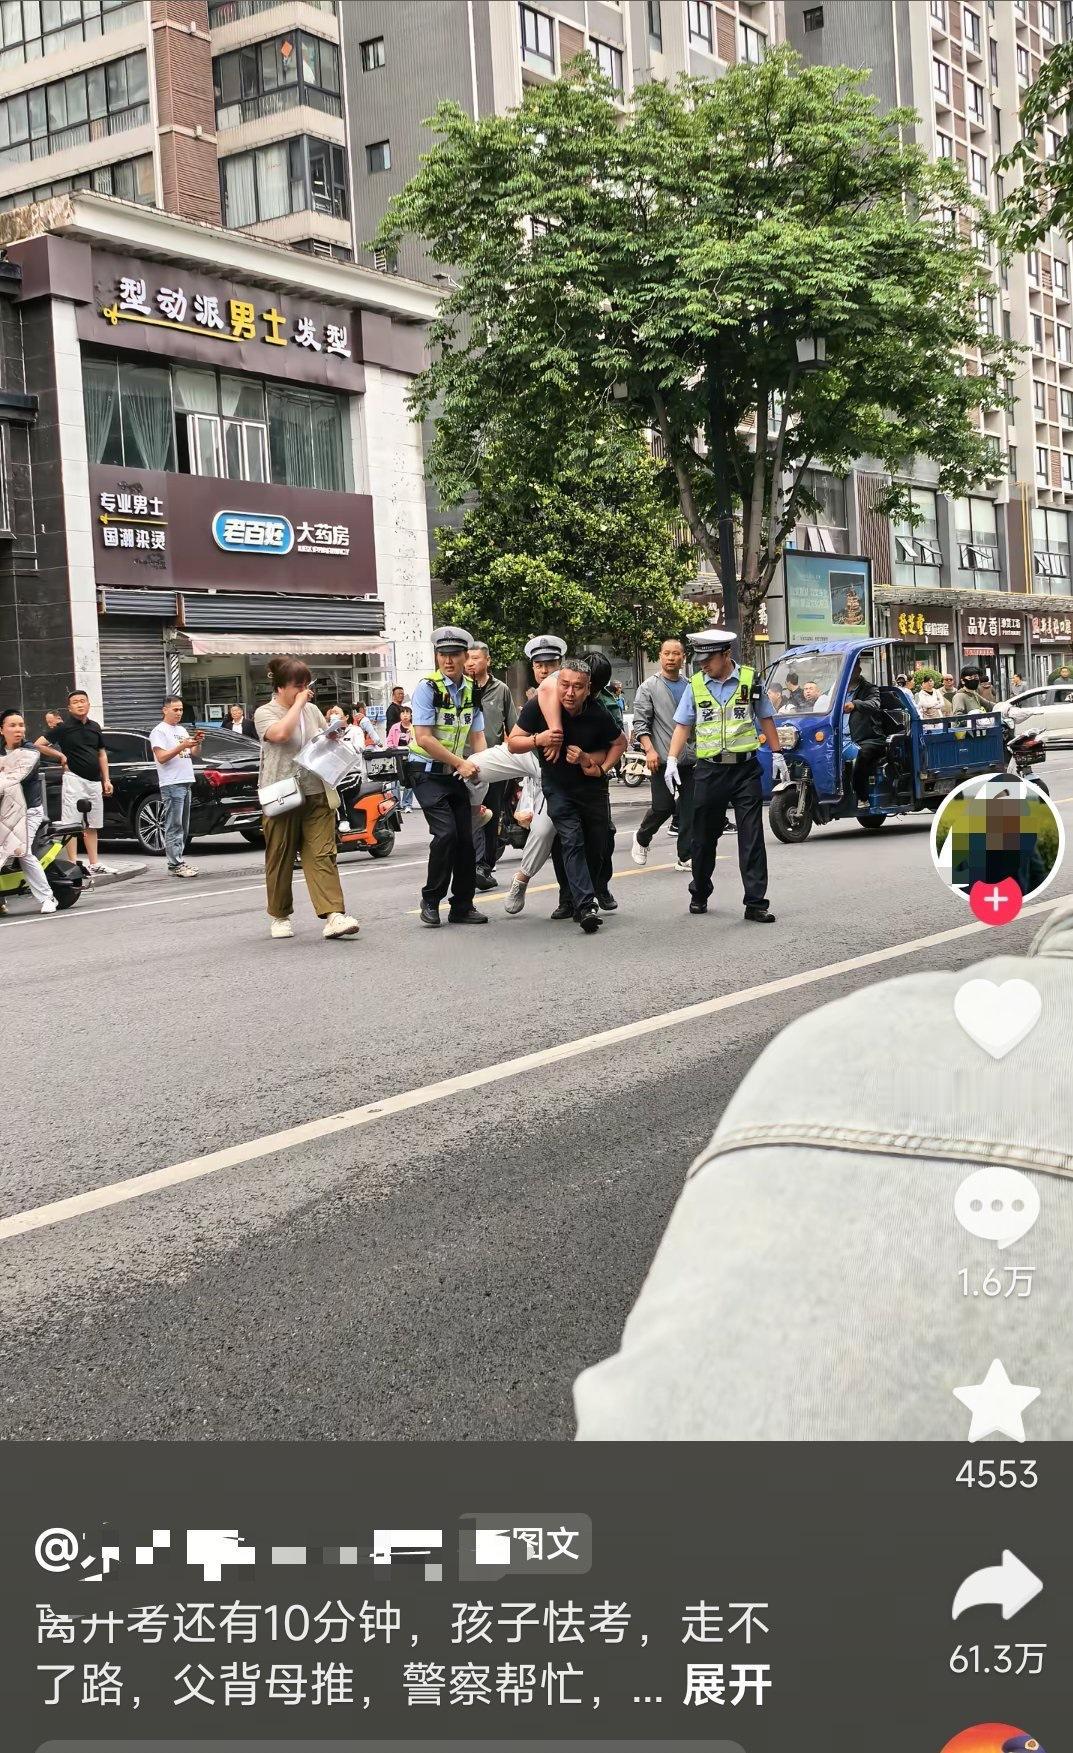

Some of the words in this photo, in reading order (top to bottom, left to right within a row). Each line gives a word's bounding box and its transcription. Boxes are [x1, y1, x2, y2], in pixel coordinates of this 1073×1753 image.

[120, 278, 351, 358] 型动派男士发型
[100, 492, 164, 516] 专业男士
[103, 527, 166, 551] 国潮染烫
[297, 522, 350, 546] 大药房
